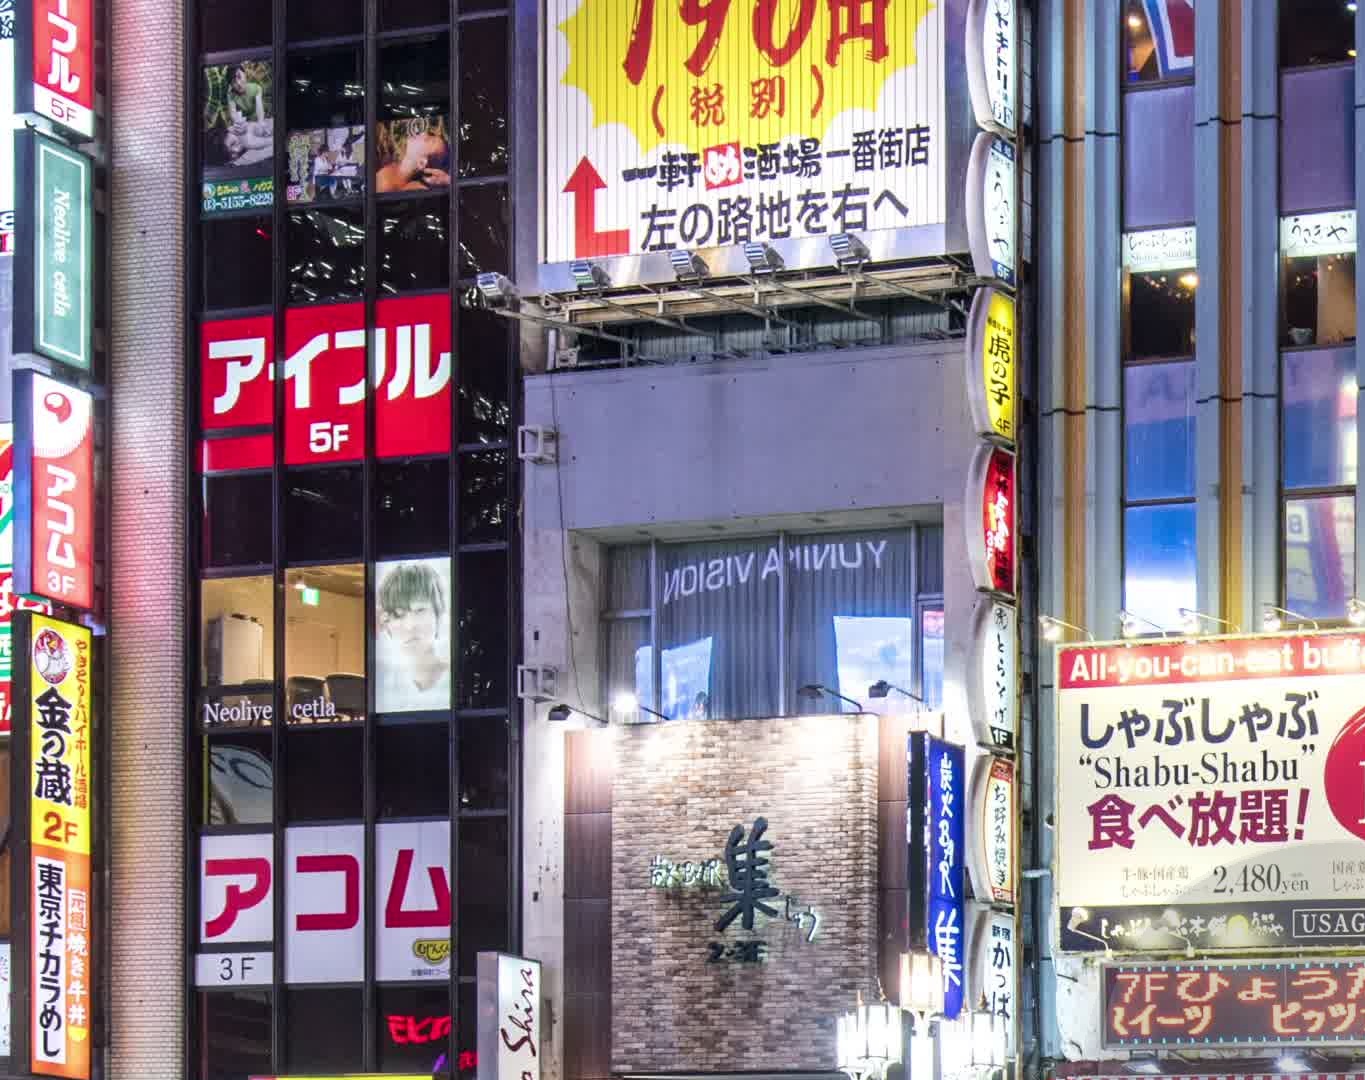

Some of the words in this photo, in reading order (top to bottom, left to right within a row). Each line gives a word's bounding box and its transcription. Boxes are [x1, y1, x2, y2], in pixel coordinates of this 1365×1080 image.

[621, 141, 822, 191] 一軒め酒場
[826, 123, 931, 171] 一番街店
[54, 189, 72, 264] Neolive
[640, 183, 909, 252] 左の路地を右へ
[208, 323, 451, 415] アイフル
[988, 336, 1011, 406] 虎の子
[309, 421, 350, 453] 5F
[993, 416, 1011, 434] 4F
[47, 466, 76, 568] アコム
[47, 571, 76, 595] 3F
[1069, 644, 1296, 683] All-you-can-eat
[203, 701, 273, 724] Neolive
[292, 699, 337, 719] cetla
[992, 728, 1014, 748] 1F
[1078, 689, 1320, 750] しゃぶしゃぶ
[35, 686, 73, 806] 金の蔵
[43, 811, 78, 844] 2F
[1087, 787, 1311, 853] 食べ放題!
[205, 849, 451, 937] アコム
[713, 815, 781, 933] 集
[1212, 863, 1282, 895] 2,480
[1281, 875, 1310, 895] yen
[37, 864, 63, 1058] 東京チカラめし
[220, 956, 255, 982] 3F
[934, 910, 962, 993] 集
[500, 966, 537, 1058] Shira
[1116, 972, 1168, 1002] 7F
